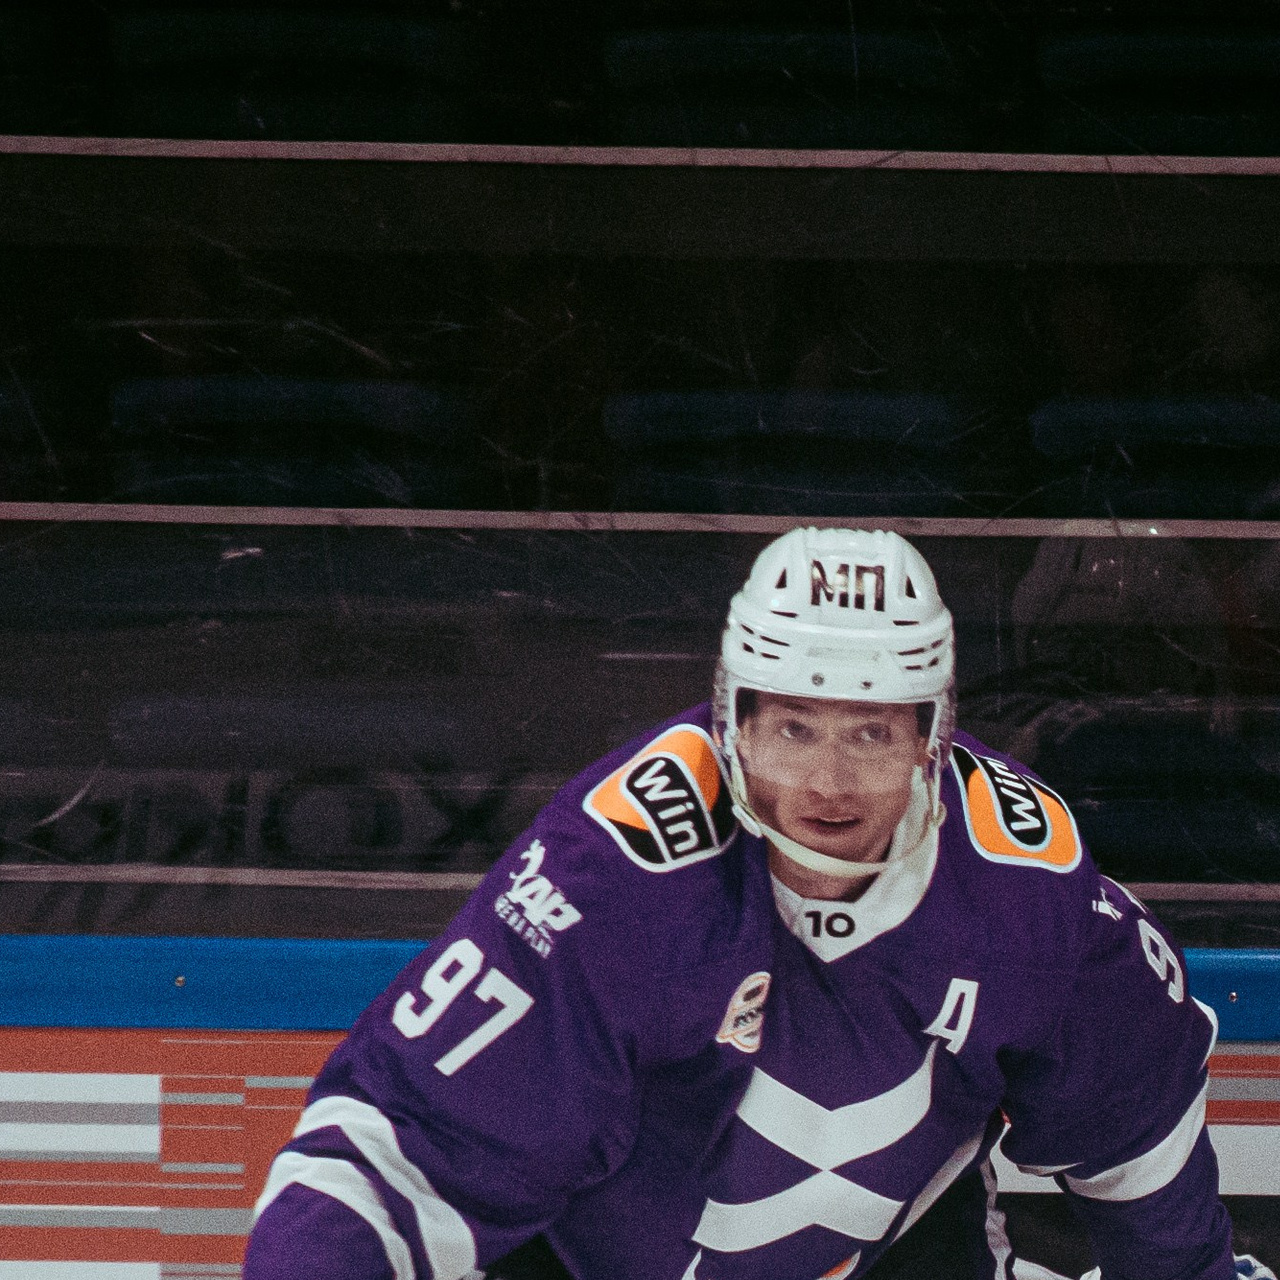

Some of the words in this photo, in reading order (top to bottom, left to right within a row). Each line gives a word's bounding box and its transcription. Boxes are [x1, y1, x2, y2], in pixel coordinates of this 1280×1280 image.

[634, 759, 700, 853] Win
[986, 759, 1042, 831] Win
[804, 910, 856, 938] 10
[392, 938, 535, 1077] 97
